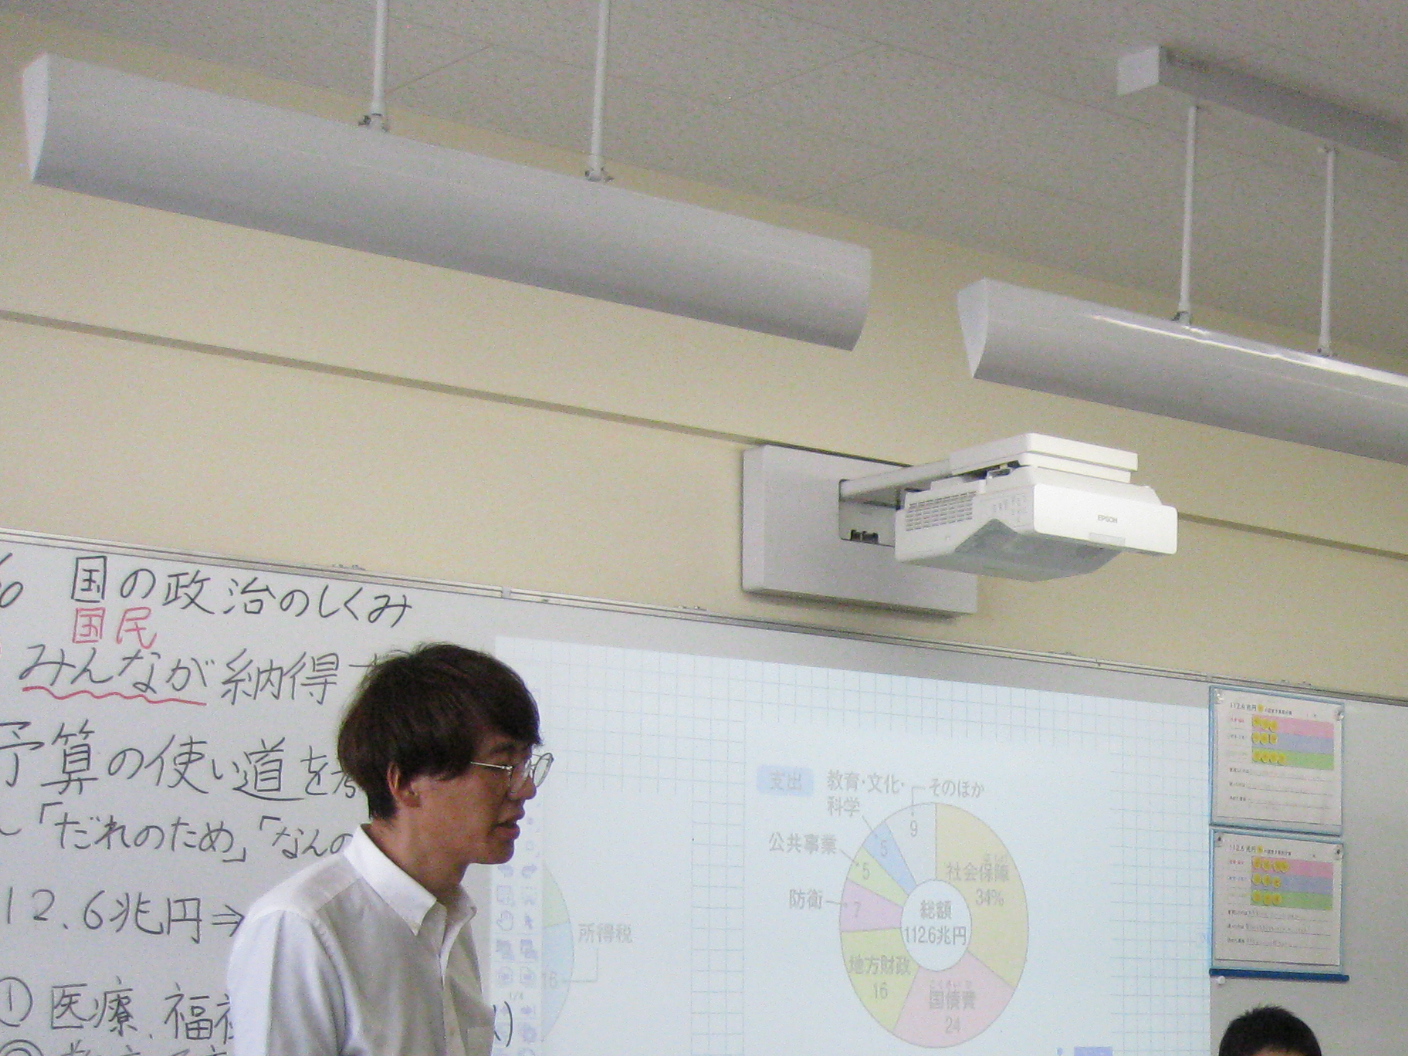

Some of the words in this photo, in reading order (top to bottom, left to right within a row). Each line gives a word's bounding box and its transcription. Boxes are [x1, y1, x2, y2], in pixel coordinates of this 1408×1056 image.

[1097, 514, 1118, 524] EPSON
[71, 555, 412, 628] 国の政治のしくみ
[72, 606, 158, 650] 国民
[928, 777, 986, 799] そのほか
[826, 795, 861, 817] 科学
[909, 819, 919, 838] 9
[767, 830, 838, 855] 公共事業
[862, 862, 871, 881] 5
[946, 861, 1010, 883] 社会保障
[919, 900, 953, 920] 総額
[578, 922, 634, 944] 所得税
[903, 926, 967, 946] 112.6兆円
[848, 955, 912, 976] 地方財政
[873, 982, 889, 1001] 16
[929, 989, 978, 1011] 国債費
[943, 1017, 962, 1035] 24
